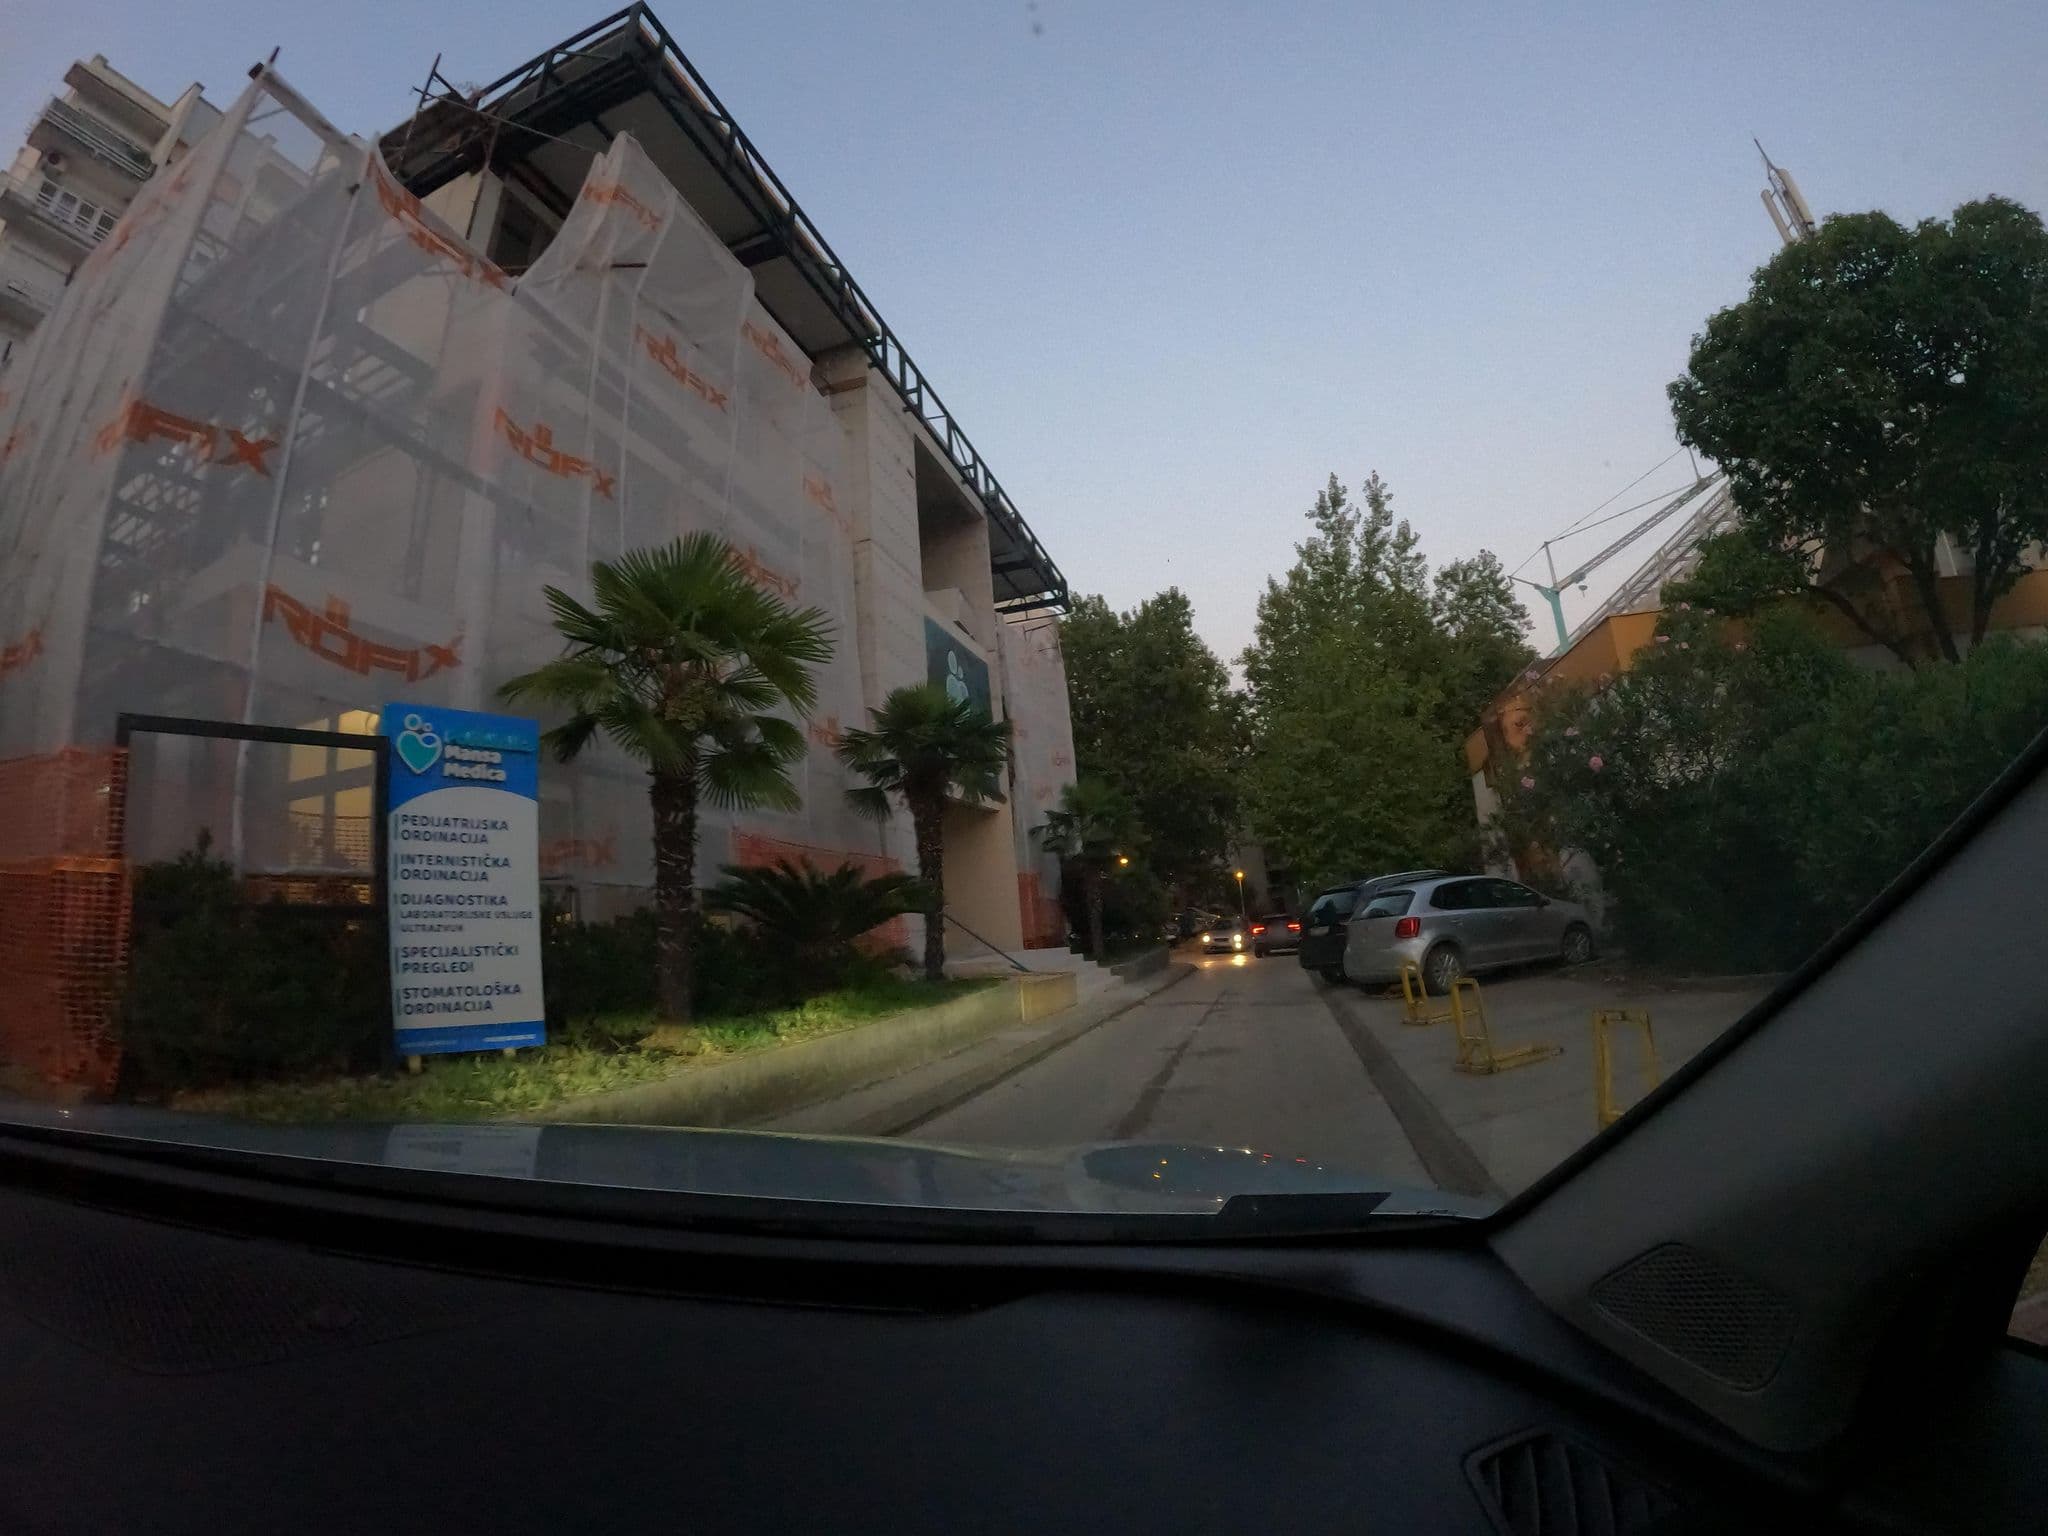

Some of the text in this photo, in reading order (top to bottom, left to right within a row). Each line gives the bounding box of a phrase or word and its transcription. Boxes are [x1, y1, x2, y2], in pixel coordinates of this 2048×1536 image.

[401, 814, 509, 831] PEDIJATRIJSKA
[401, 829, 489, 844] ORDINACIJA
[401, 853, 511, 869] INTERNISTIČKA
[401, 869, 489, 882] ORDINACIJA
[400, 893, 509, 906] DIJAGNOSTIKA
[401, 942, 519, 959] SPECIJALISTIČKI
[402, 961, 474, 974] PREGLEDI
[402, 982, 521, 999] STOMATOLOŠKA
[404, 1000, 493, 1015] ORDINACIJA
